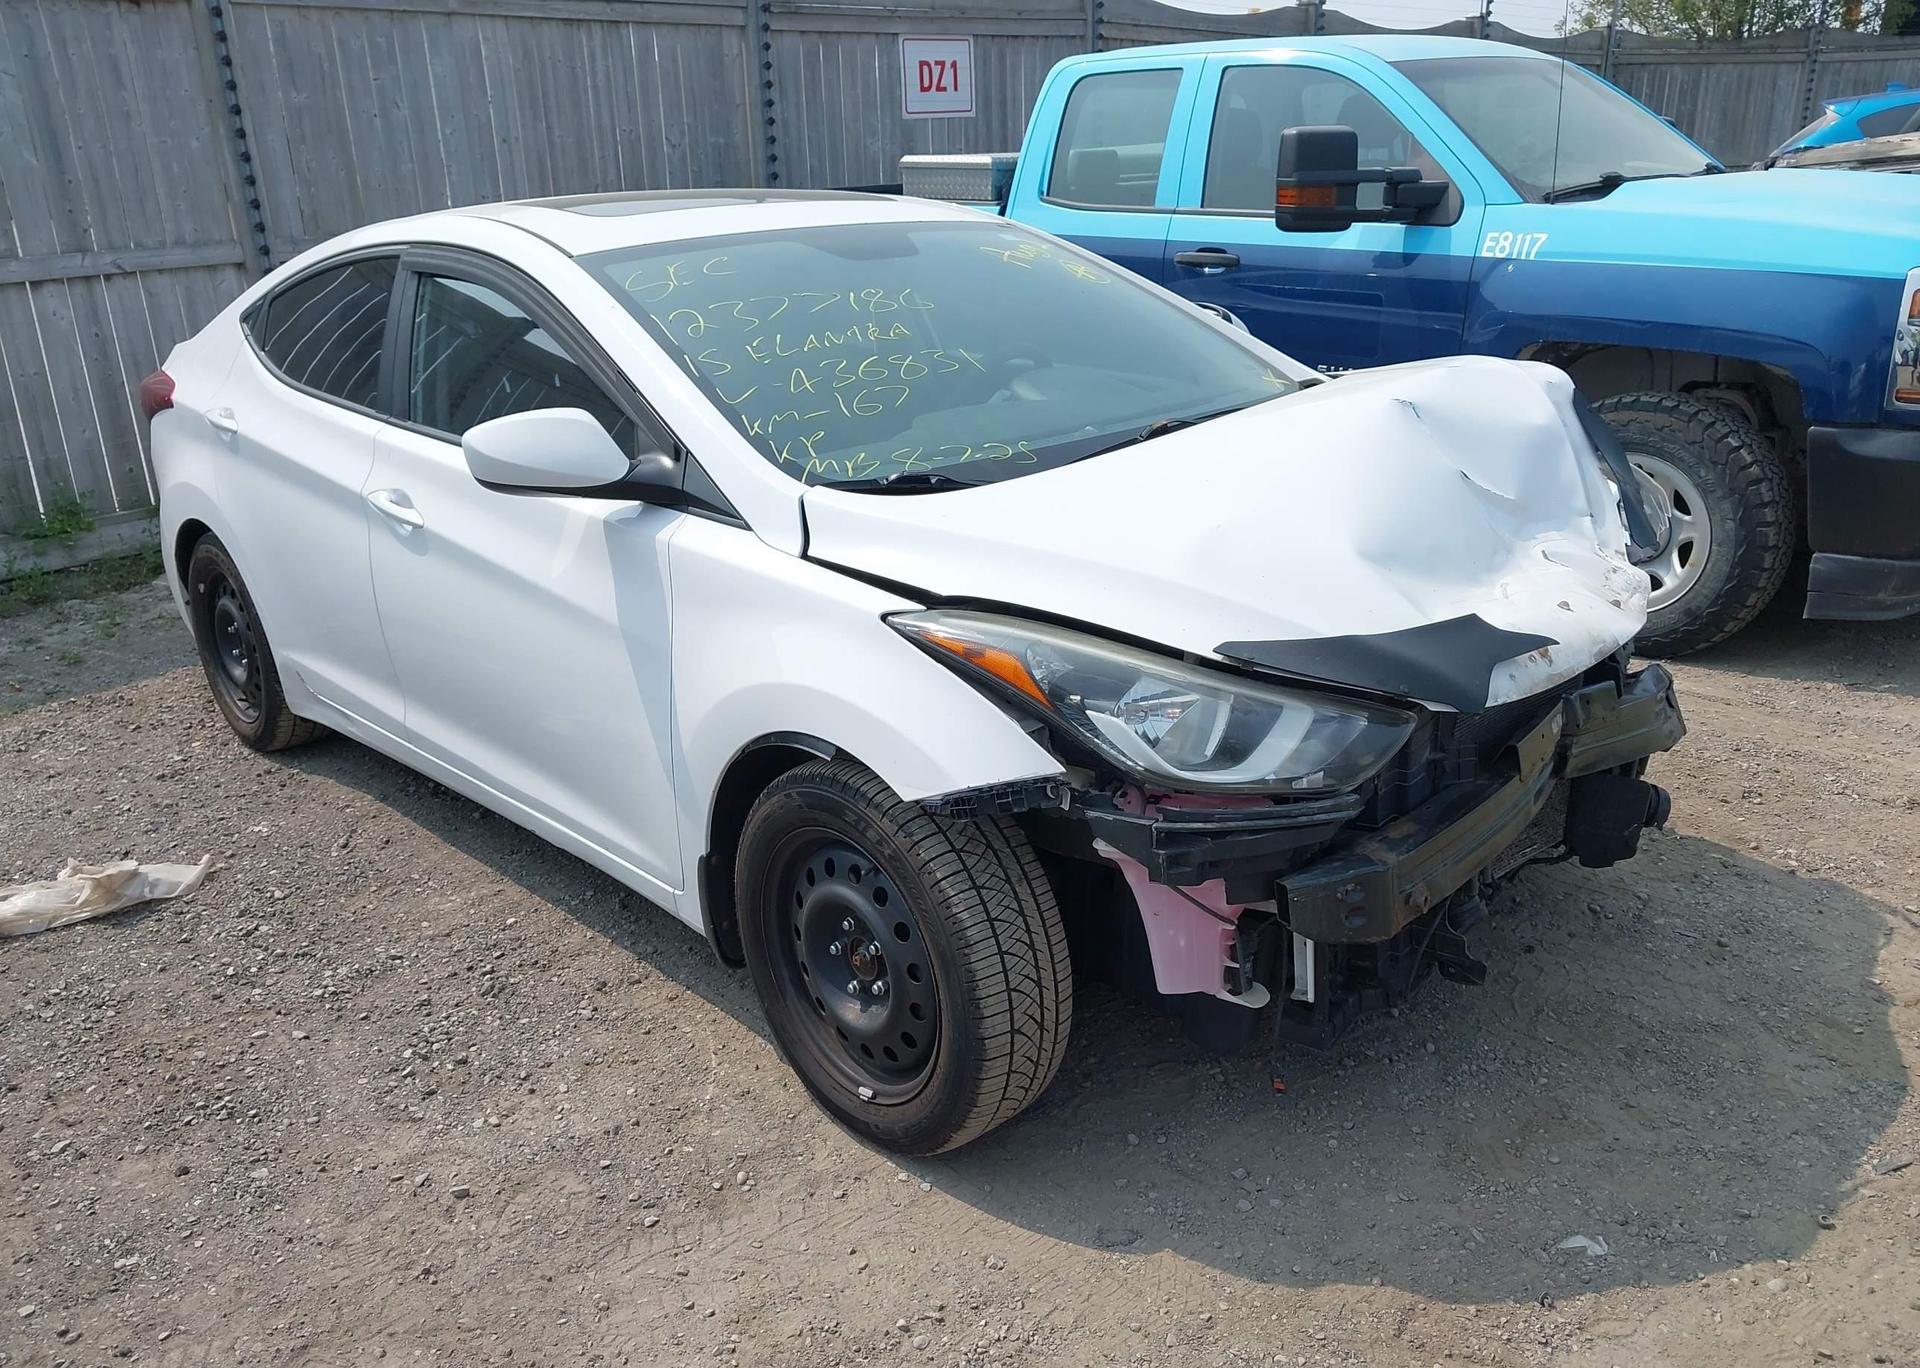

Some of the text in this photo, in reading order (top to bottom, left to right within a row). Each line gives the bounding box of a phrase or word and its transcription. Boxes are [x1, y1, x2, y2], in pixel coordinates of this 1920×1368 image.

[918, 59, 959, 93] DZ1
[1480, 230, 1549, 260] E8117
[625, 256, 737, 302] SEC
